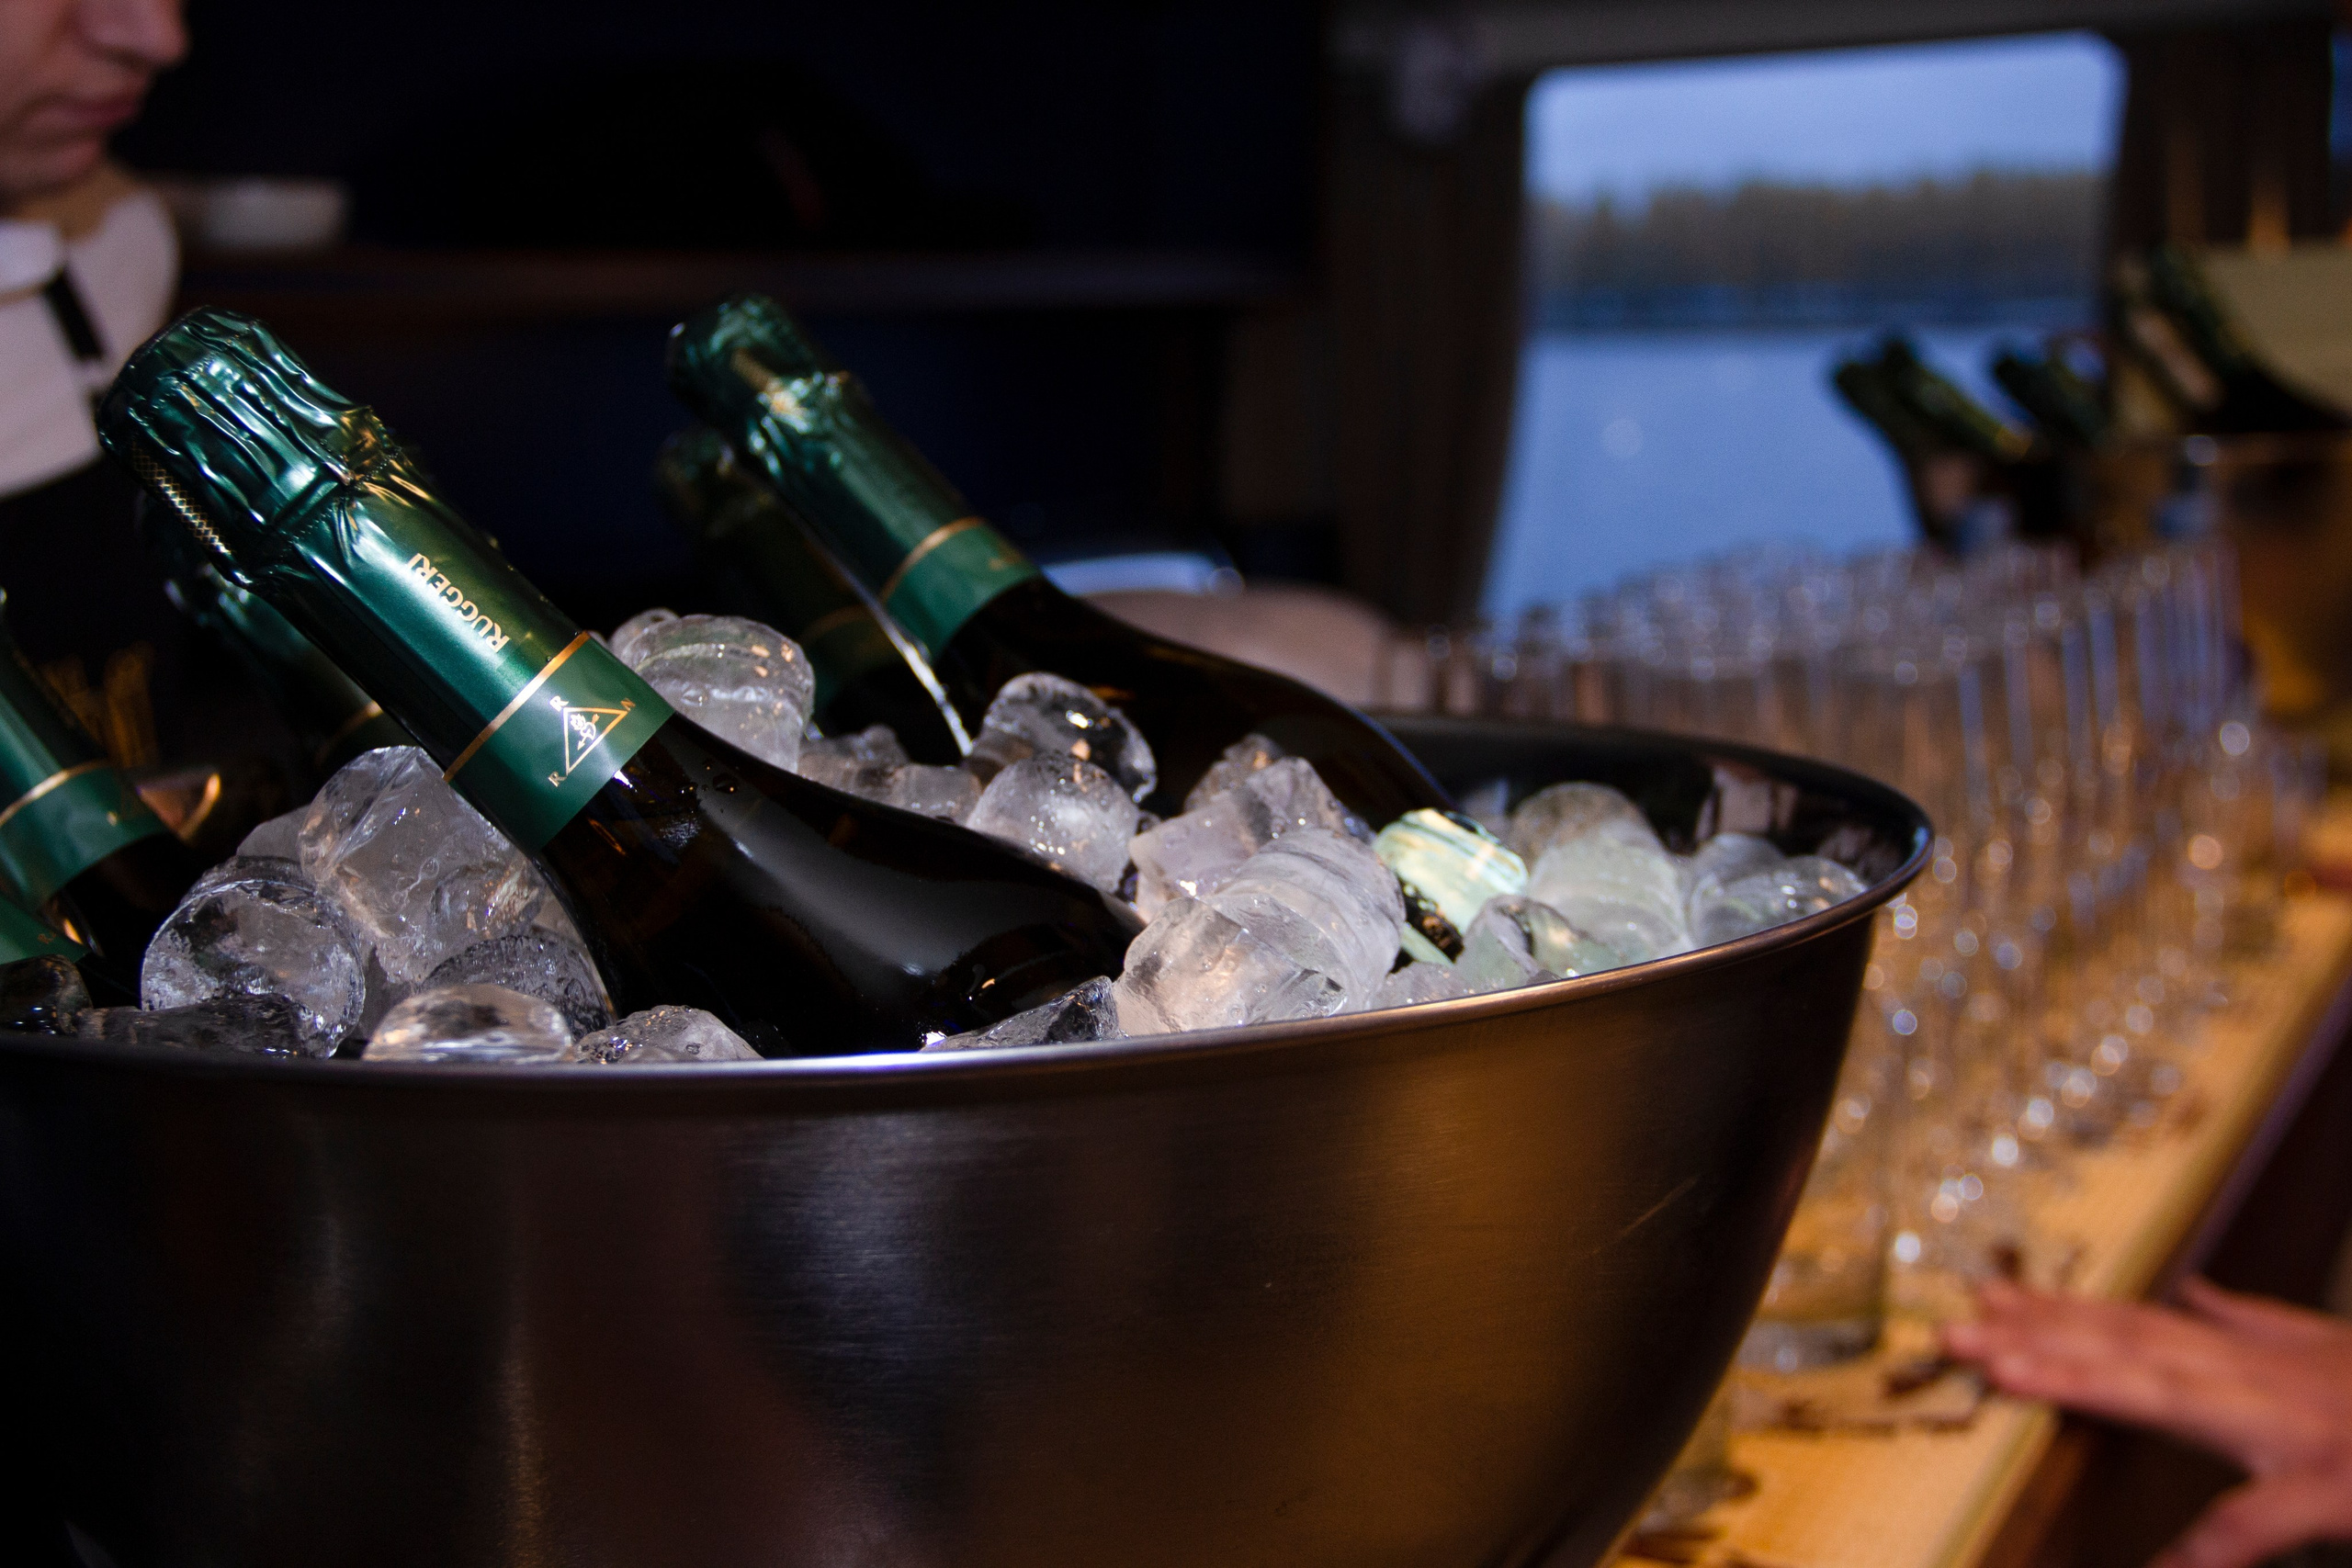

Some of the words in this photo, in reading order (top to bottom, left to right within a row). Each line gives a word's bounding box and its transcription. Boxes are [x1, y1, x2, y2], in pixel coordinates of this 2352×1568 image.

[410, 553, 510, 653] RUGGERI
[549, 695, 569, 712] R
[548, 771, 567, 787] R
